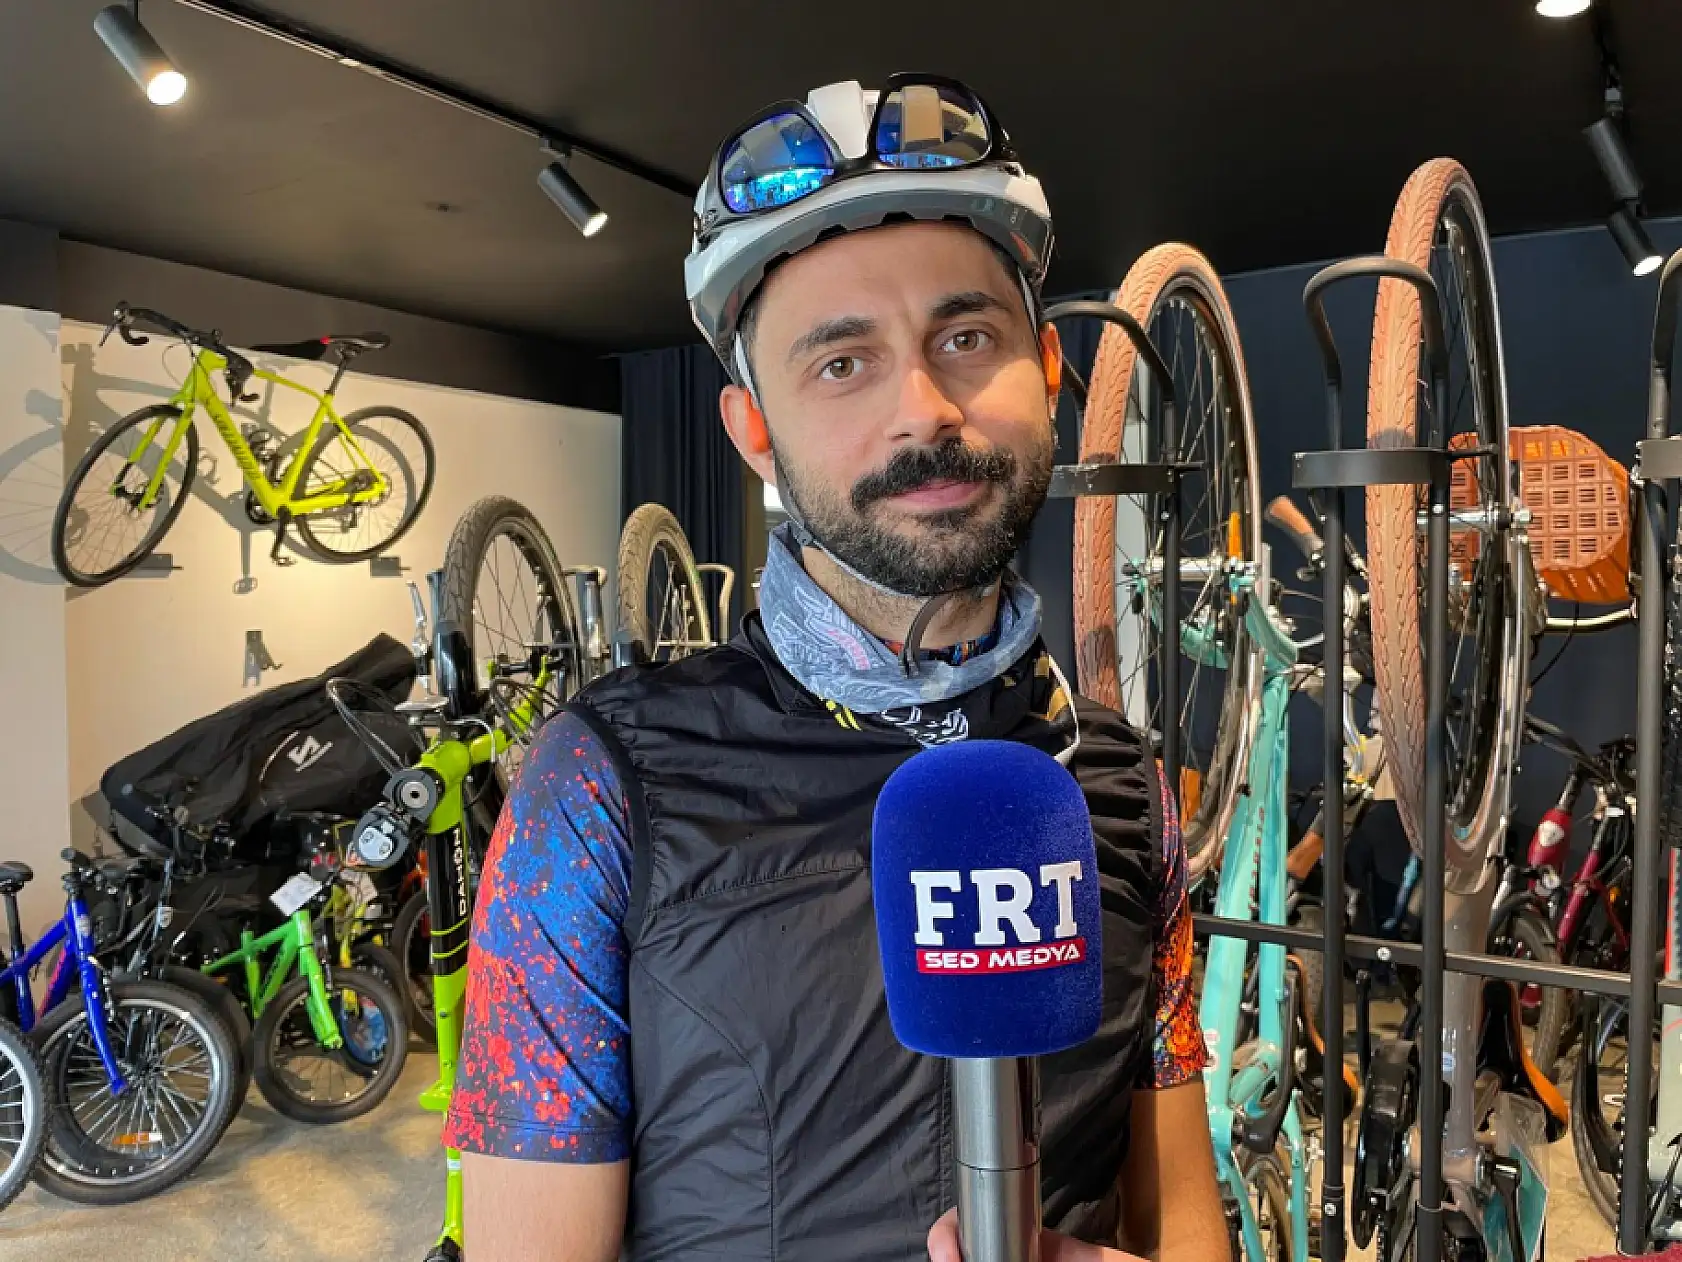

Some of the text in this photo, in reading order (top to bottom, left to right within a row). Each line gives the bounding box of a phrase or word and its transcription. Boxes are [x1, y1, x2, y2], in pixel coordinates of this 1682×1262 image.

[910, 860, 1083, 946] FRT
[924, 943, 1081, 969] SED MEDYA
